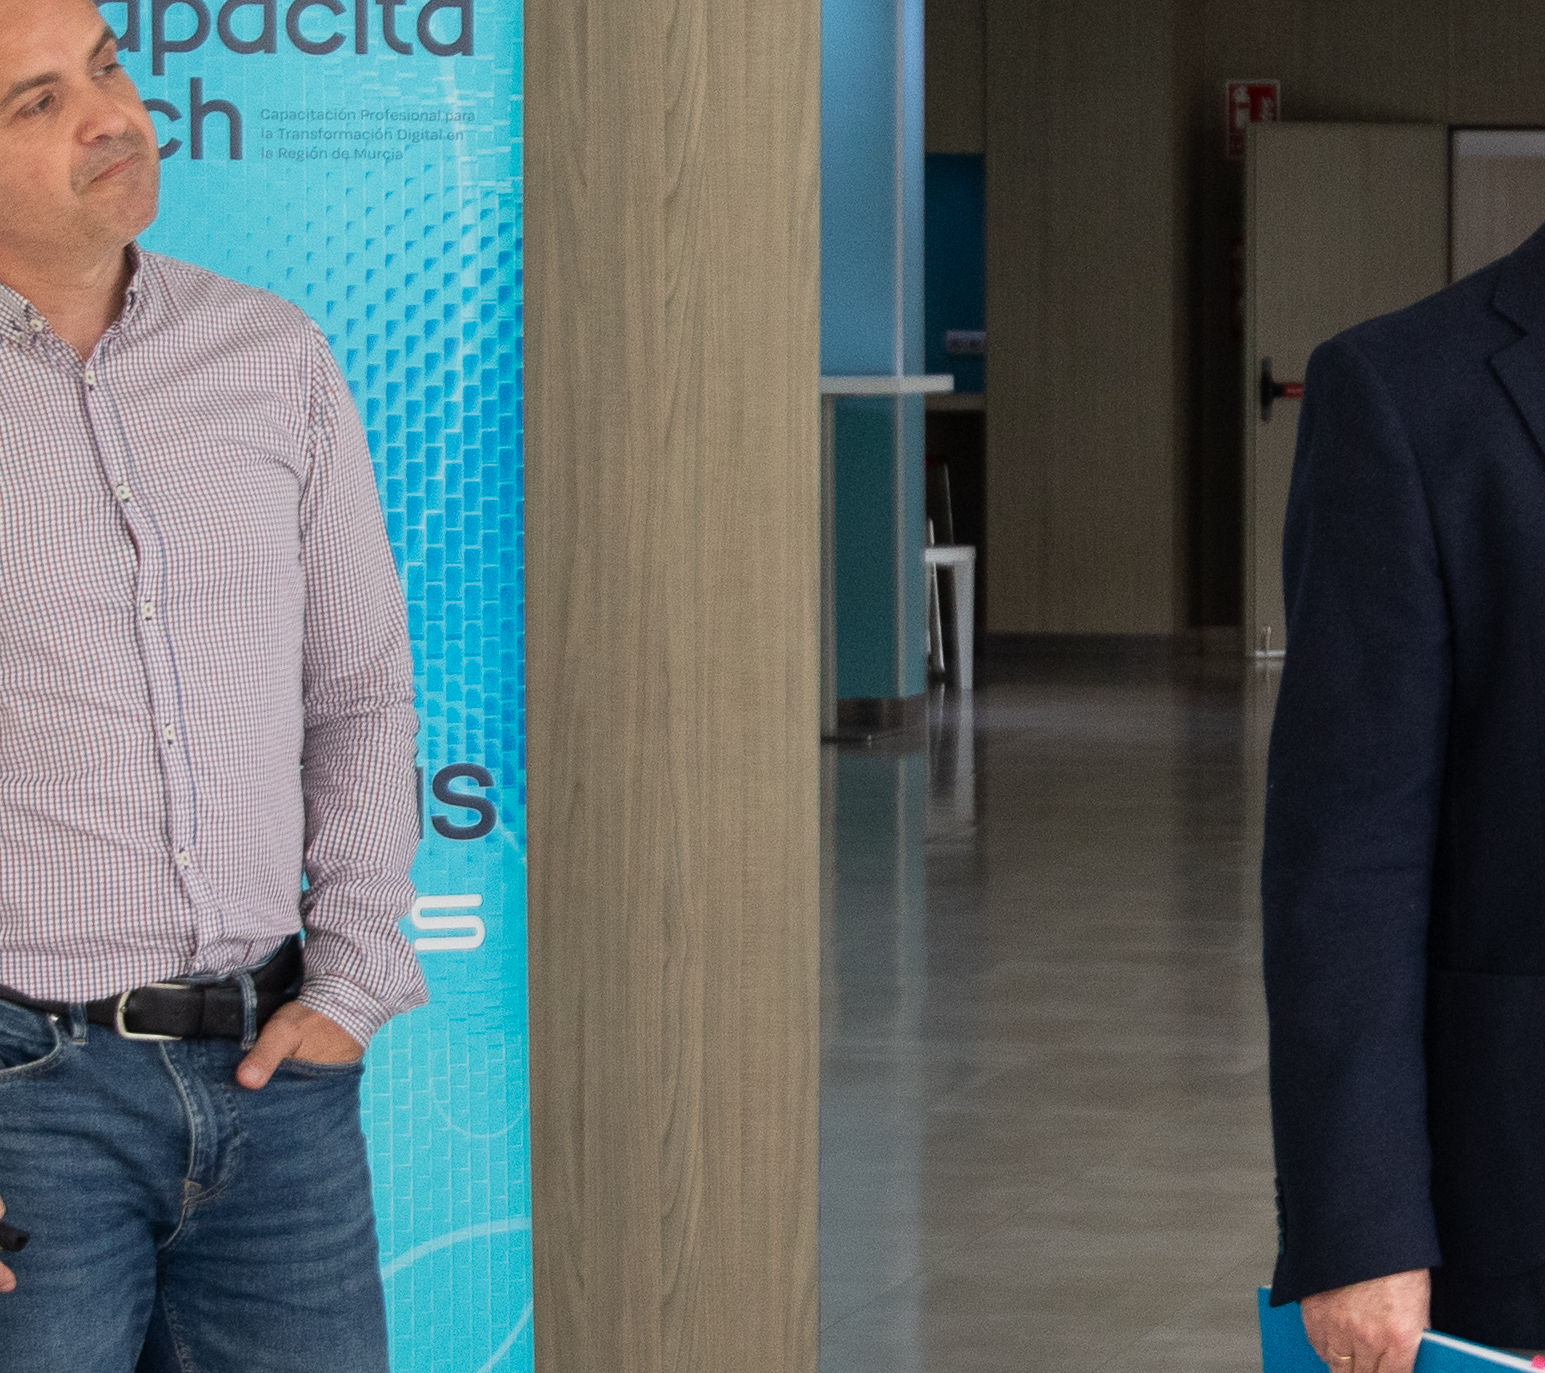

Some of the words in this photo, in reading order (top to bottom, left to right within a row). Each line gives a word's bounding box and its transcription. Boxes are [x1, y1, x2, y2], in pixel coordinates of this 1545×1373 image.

[142, 77, 244, 161] ch
[260, 107, 356, 124] Capacitación
[360, 107, 440, 123] Profesional
[442, 110, 476, 125] para
[260, 127, 273, 140] la
[277, 127, 393, 141] Transformación
[396, 127, 442, 144] Digital
[446, 131, 464, 142] en
[260, 146, 273, 159] la
[277, 146, 328, 162] Región
[331, 147, 349, 160] de
[353, 147, 404, 162] Murcia
